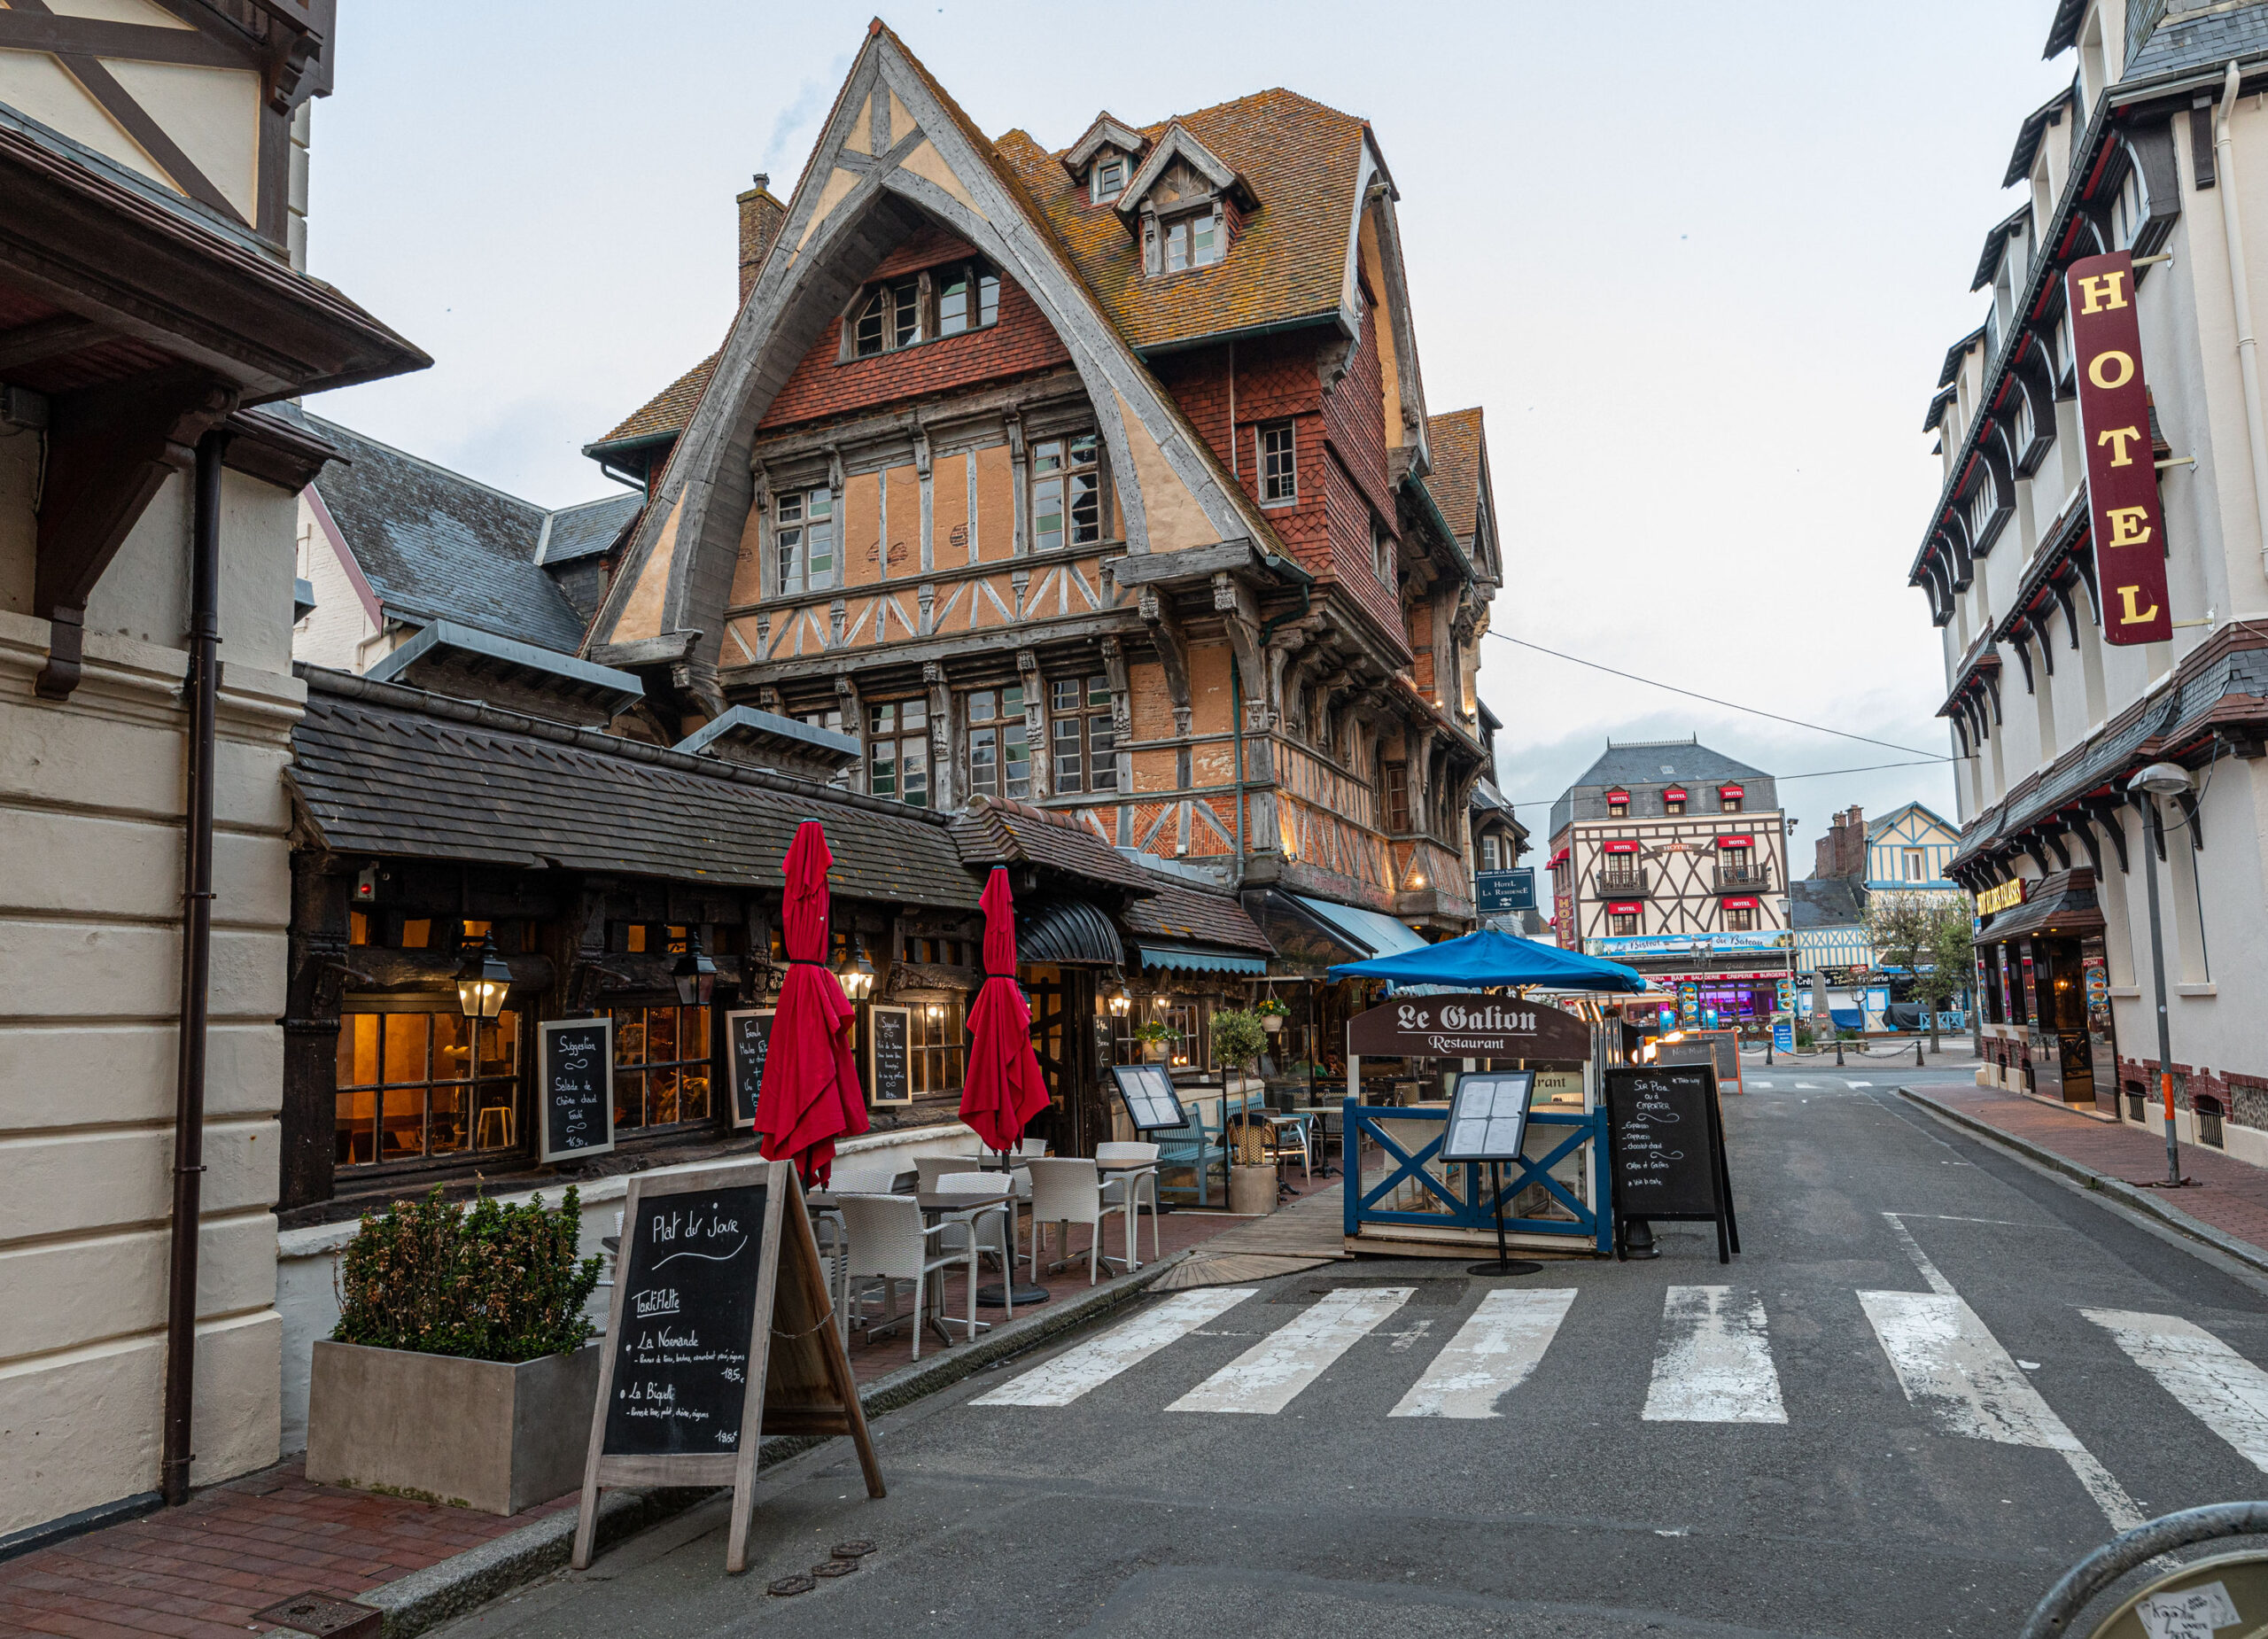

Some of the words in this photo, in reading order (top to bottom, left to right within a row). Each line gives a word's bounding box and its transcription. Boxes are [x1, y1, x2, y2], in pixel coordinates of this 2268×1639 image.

[2078, 270, 2158, 625] HOTEL
[1558, 898, 1571, 950] HOTEL
[1615, 942, 1627, 952] Le
[1630, 938, 1661, 951] Bistrot
[1716, 935, 1727, 944] du
[1730, 935, 1763, 946] Bateau
[1397, 1005, 1430, 1029] Le
[1440, 1005, 1537, 1031] Galion
[558, 1035, 596, 1056] Suggestion
[1428, 1035, 1504, 1053] Restaurant
[555, 1077, 579, 1091] Salade
[584, 1080, 592, 1091] de
[1533, 1077, 1566, 1088] rant
[556, 1095, 576, 1107] Chèvre
[581, 1094, 598, 1104] chaud
[1654, 1091, 1659, 1100] à
[653, 1210, 681, 1243] Plat
[685, 1210, 703, 1238] du
[637, 1331, 654, 1349] La
[658, 1325, 699, 1348] Normande
[628, 1381, 641, 1399] La
